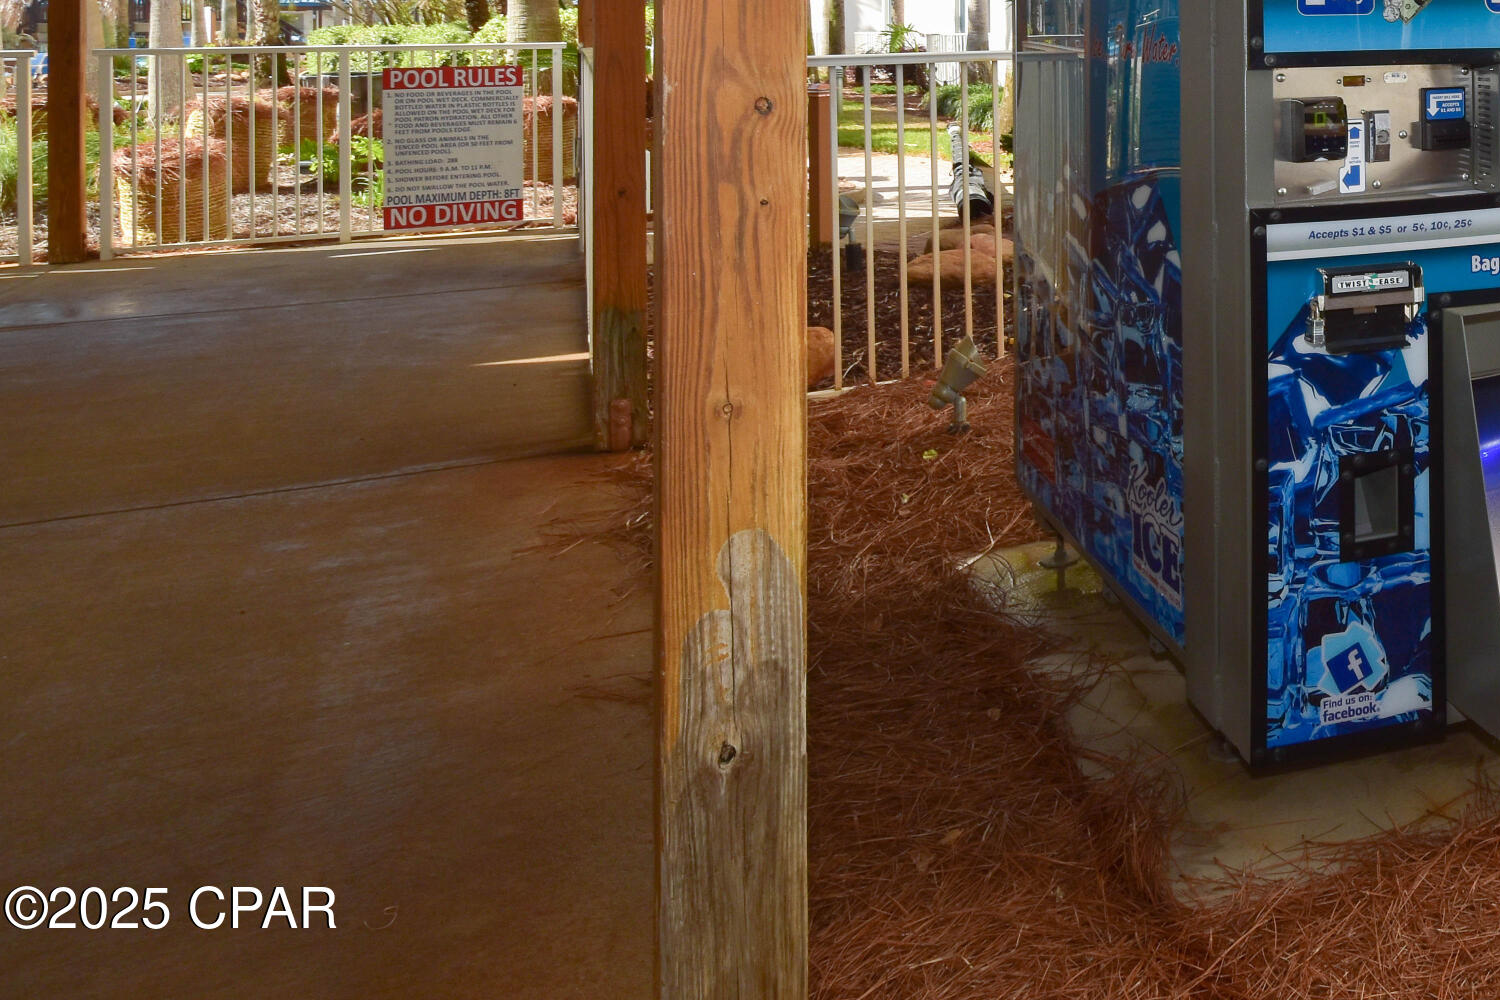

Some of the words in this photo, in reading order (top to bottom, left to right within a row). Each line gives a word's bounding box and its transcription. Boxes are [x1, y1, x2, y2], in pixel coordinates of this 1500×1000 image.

[390, 69, 449, 89] POOL
[454, 68, 518, 87] RULES
[395, 149, 430, 157] UNFENCED
[387, 194, 414, 206] POOL
[415, 191, 467, 204] MAXIMUM
[469, 190, 502, 201] DEPTH:
[504, 188, 520, 199] 8FT
[390, 206, 428, 227] NO
[435, 200, 518, 224] DIVING
[1308, 227, 1349, 241] Accepts
[1352, 226, 1366, 238] $1
[1367, 226, 1376, 236] &
[1379, 224, 1392, 235] $5
[1397, 225, 1407, 233] or
[1454, 218, 1473, 230] 25¢
[1340, 281, 1366, 289] TWIST
[1128, 463, 1183, 527] Kooler
[1131, 500, 1180, 594] ICE
[1323, 699, 1342, 710] Find
[1346, 696, 1356, 705] us
